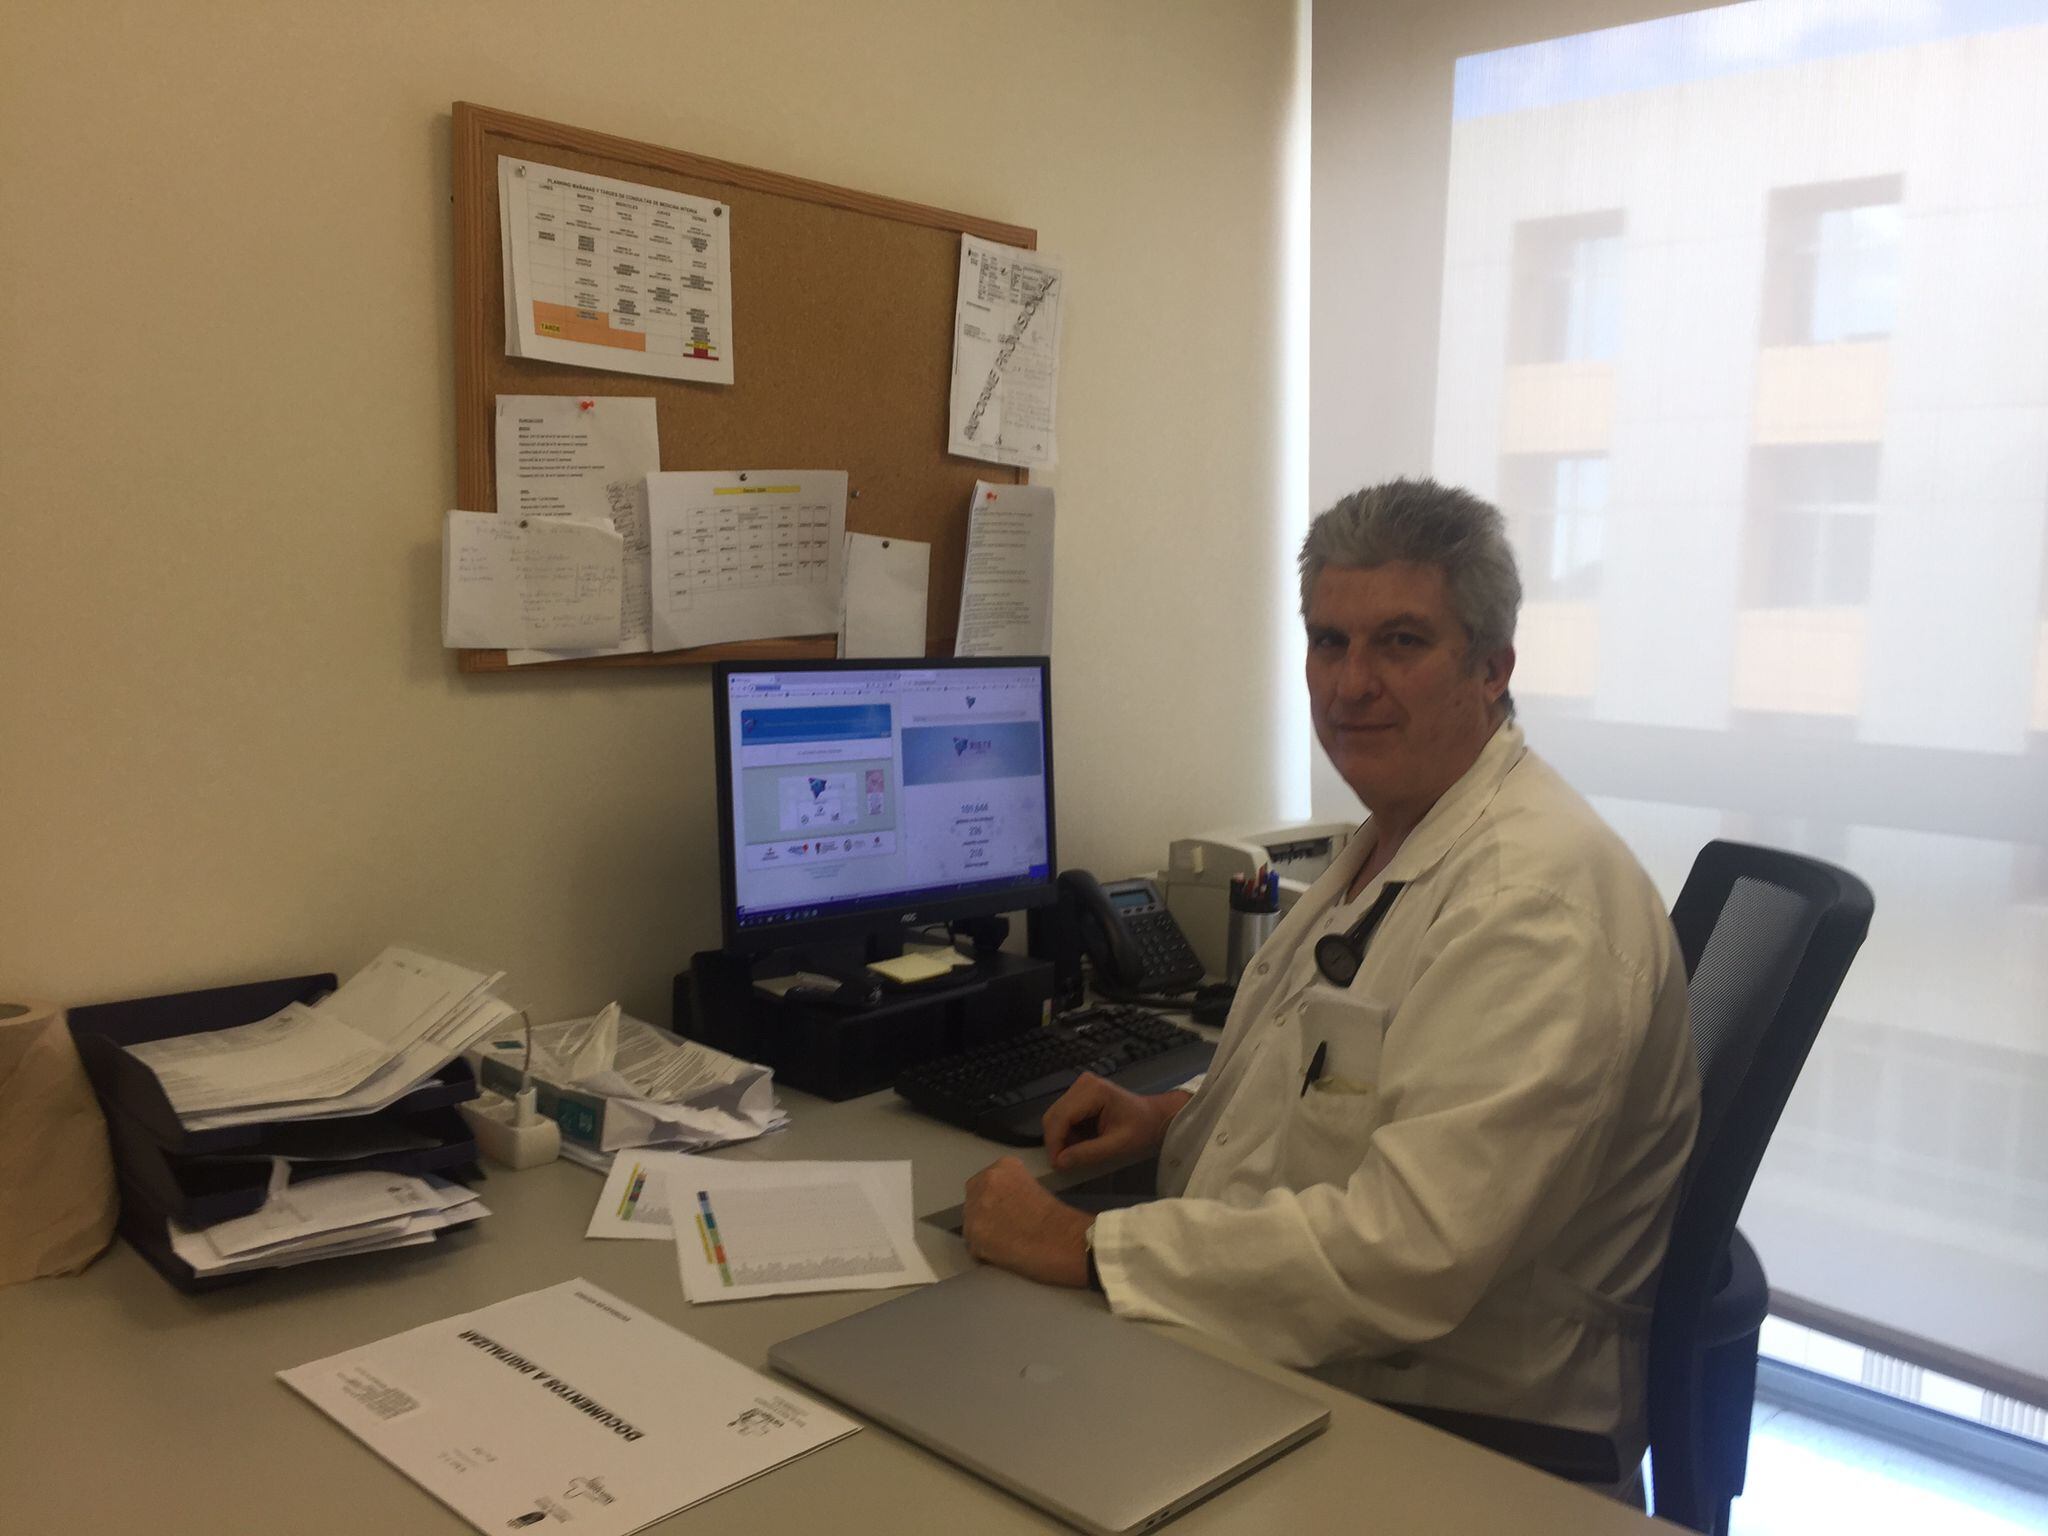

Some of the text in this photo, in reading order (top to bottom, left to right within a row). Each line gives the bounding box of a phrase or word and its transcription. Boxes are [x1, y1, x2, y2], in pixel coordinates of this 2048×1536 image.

[457, 1329, 645, 1443] DOCUMENTOS A DIGITALIZAR
